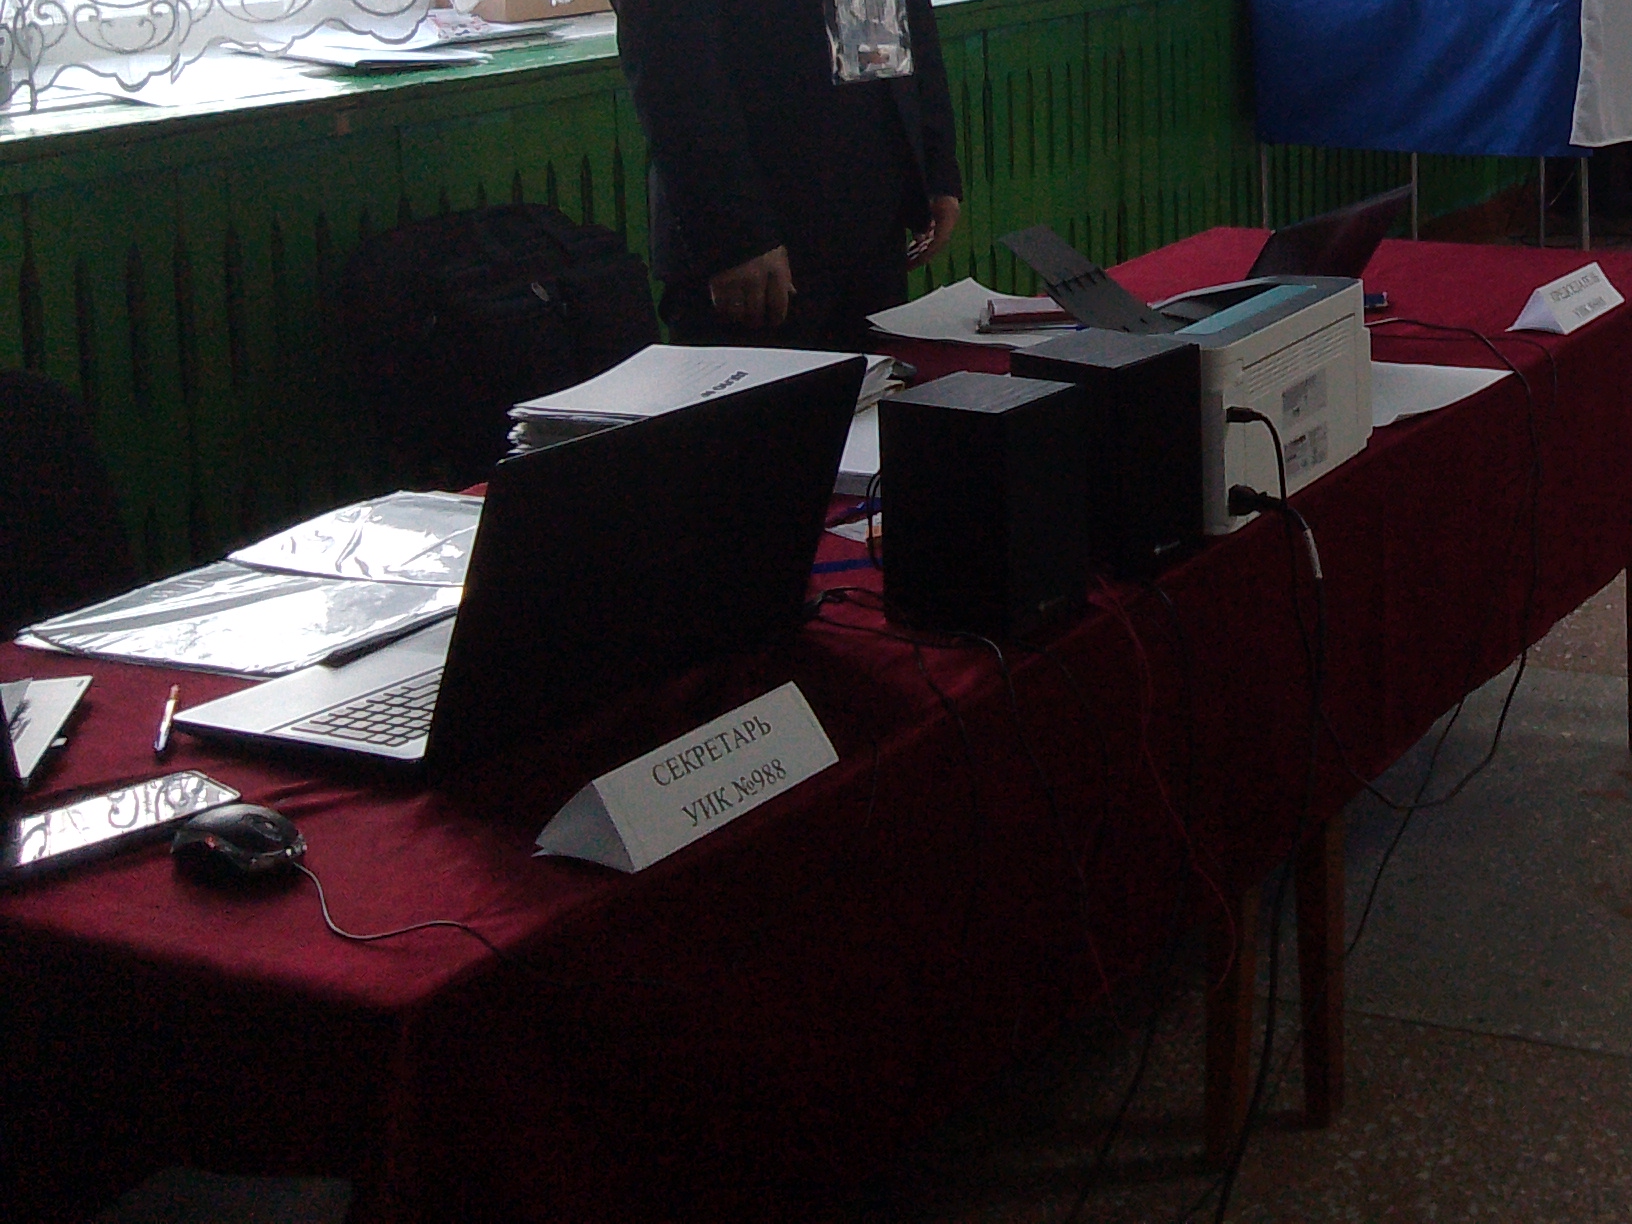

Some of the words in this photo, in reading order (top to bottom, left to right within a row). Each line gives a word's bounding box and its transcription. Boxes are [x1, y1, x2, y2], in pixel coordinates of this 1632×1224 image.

[651, 715, 772, 787] СЕКРЕТАРЬ
[681, 786, 734, 827] УИК
[730, 758, 787, 802] №988
